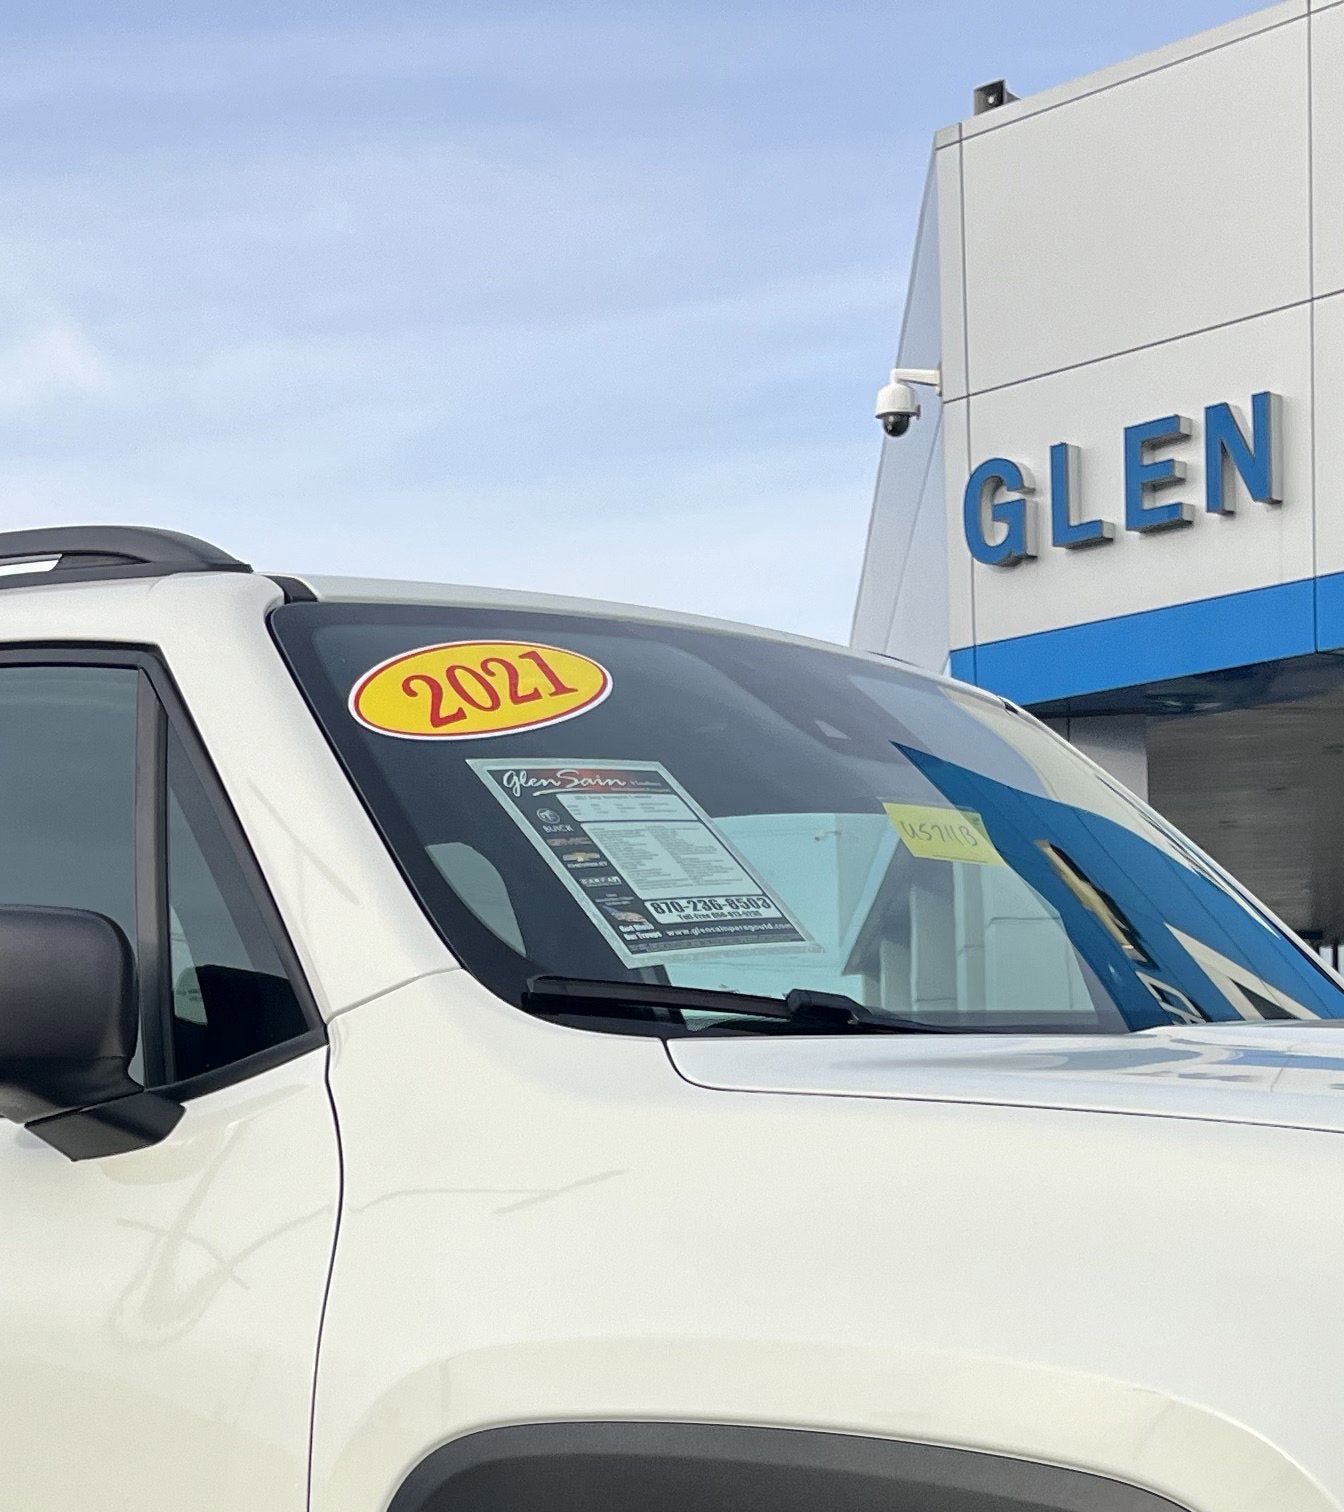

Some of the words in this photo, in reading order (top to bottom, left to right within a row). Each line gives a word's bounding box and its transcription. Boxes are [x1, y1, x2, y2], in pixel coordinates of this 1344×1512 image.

[963, 390, 1284, 568] GLEN
[401, 650, 578, 728] 2021
[503, 769, 561, 797] Glen
[556, 769, 626, 789] Sain
[650, 897, 772, 915] 870-236-8503
